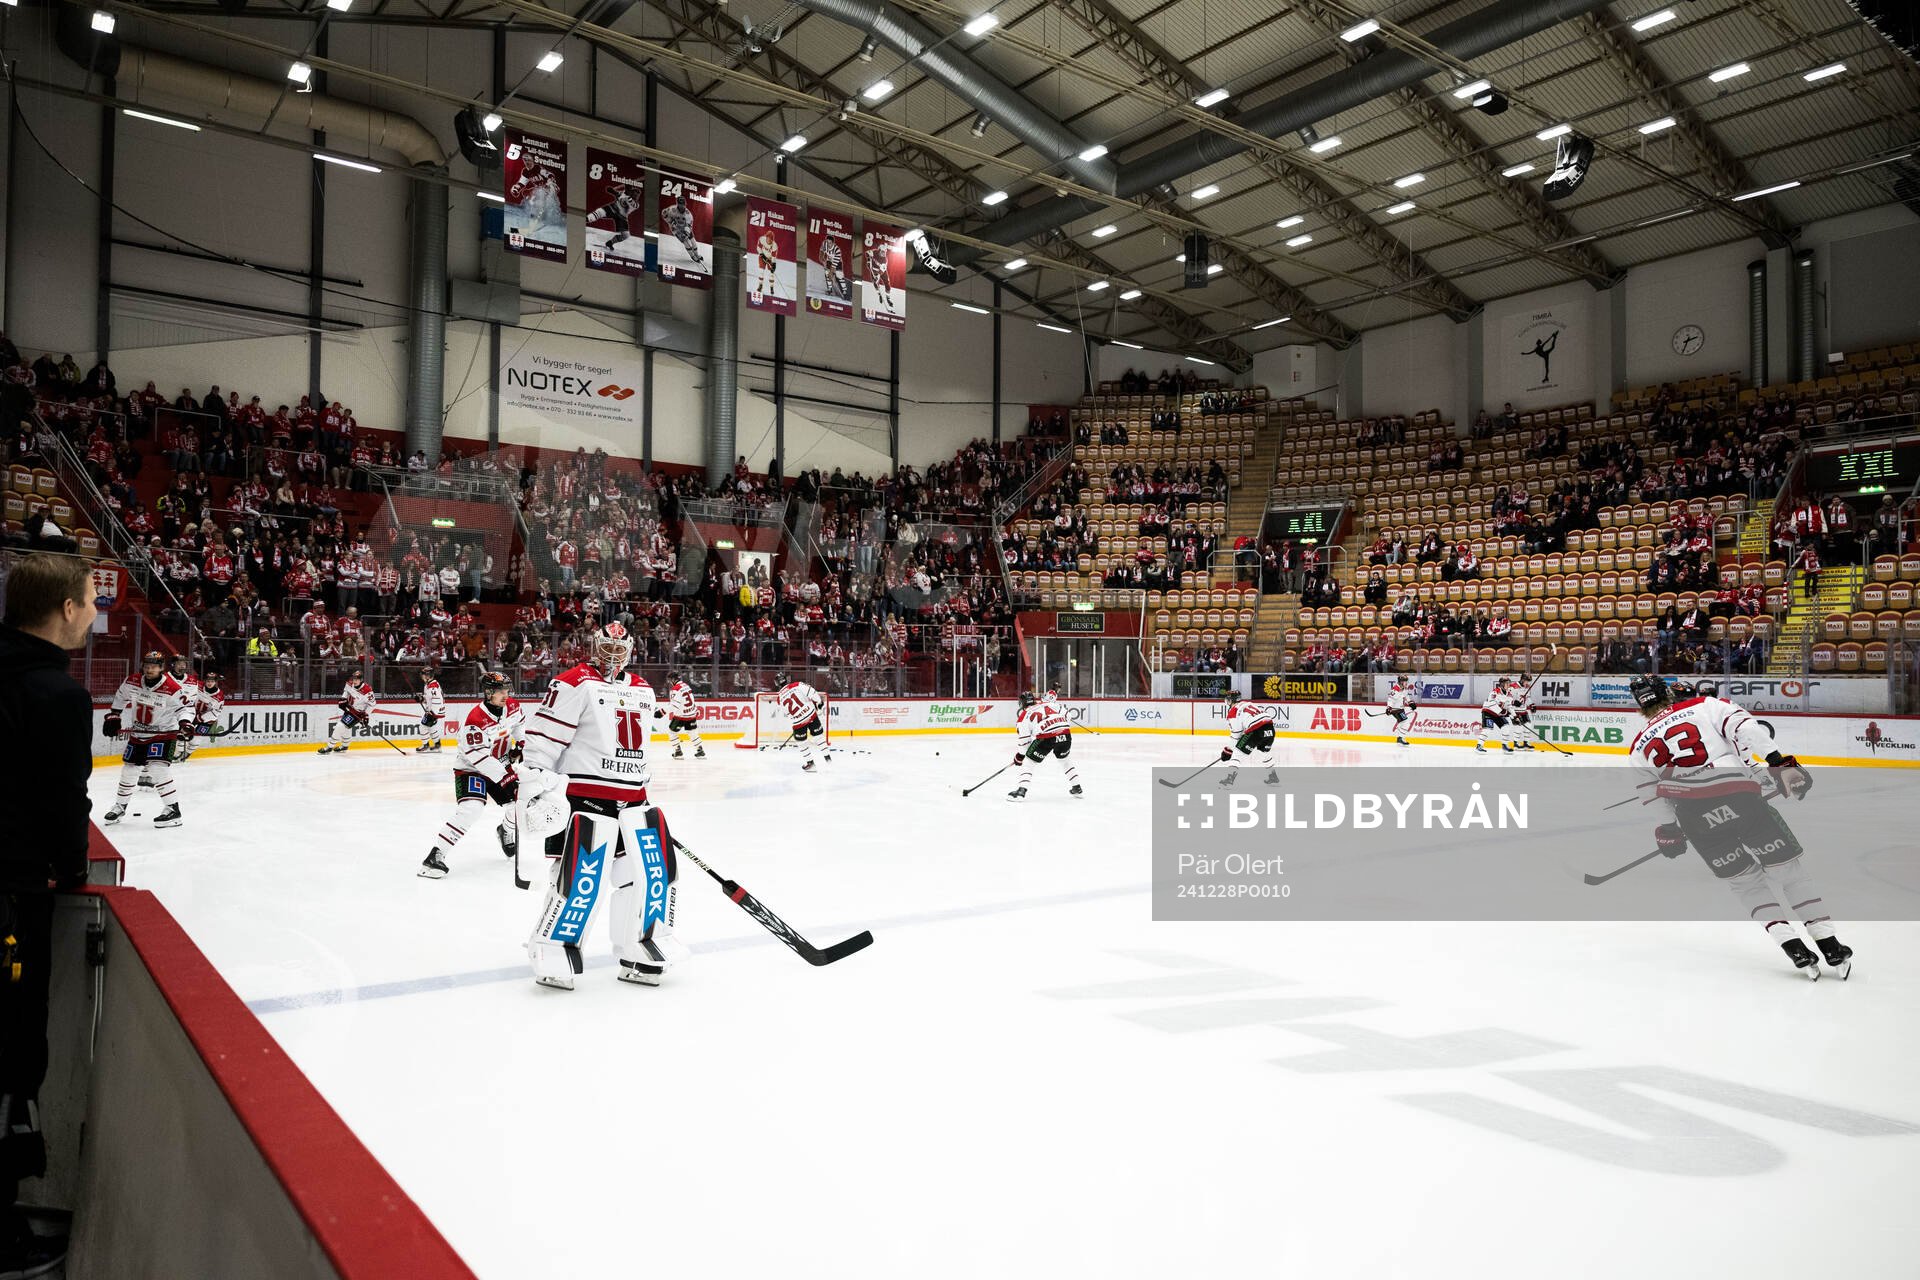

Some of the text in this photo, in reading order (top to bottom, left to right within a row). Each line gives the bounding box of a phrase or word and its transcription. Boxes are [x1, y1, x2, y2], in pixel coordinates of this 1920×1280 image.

[522, 136, 549, 149] Lennart
[507, 144, 522, 160] 5
[534, 156, 565, 172] Svedberg
[589, 164, 603, 180] 8
[661, 180, 682, 197] 24
[750, 211, 766, 227] 21
[810, 219, 820, 234] 11
[865, 233, 873, 247] 8
[532, 356, 612, 376] Vi bygger för seger!
[508, 368, 592, 397] NOTEX
[1838, 450, 1899, 480] XXL
[1190, 687, 1219, 695] HUSET
[1431, 685, 1456, 698] golv
[1542, 682, 1570, 696] HH
[783, 693, 804, 715] 21
[930, 704, 974, 716] Byberg
[1140, 711, 1162, 719] SCA
[1310, 707, 1362, 731] ABB
[1555, 715, 1614, 723] RENHÅLLNINGS
[466, 732, 484, 745] 89
[1055, 735, 1066, 743] NA
[1534, 725, 1624, 743] TIRAB
[618, 749, 643, 758] ÖREBRO
[1702, 804, 1739, 828] NA
[640, 834, 664, 917] HEROK
[558, 858, 599, 937] HEROK
